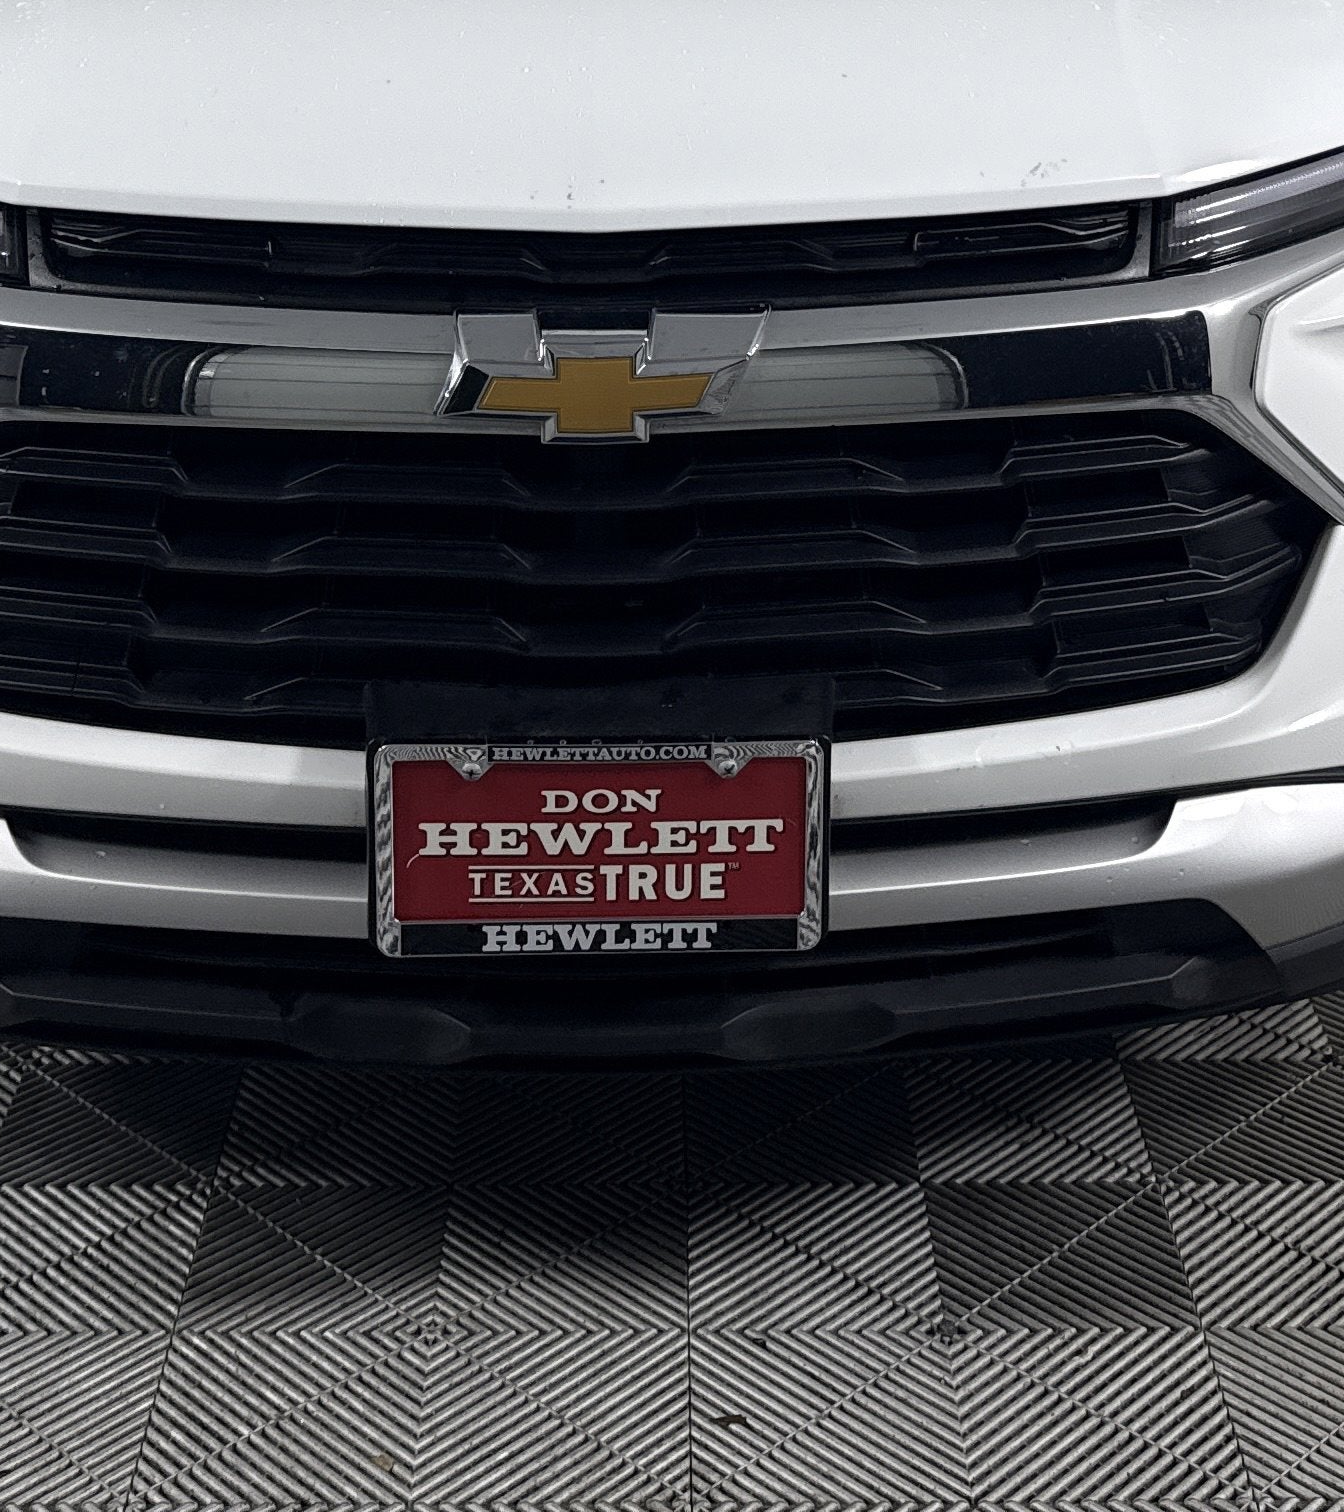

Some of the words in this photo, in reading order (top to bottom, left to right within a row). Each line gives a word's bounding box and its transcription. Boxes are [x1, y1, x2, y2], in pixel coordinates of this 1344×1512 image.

[492, 744, 708, 761] HEWLETTAUTO.COM
[540, 789, 662, 813] DON
[418, 819, 784, 856] HEWLETT
[468, 872, 595, 897] TEXAS
[482, 922, 718, 952] HEWLETT
